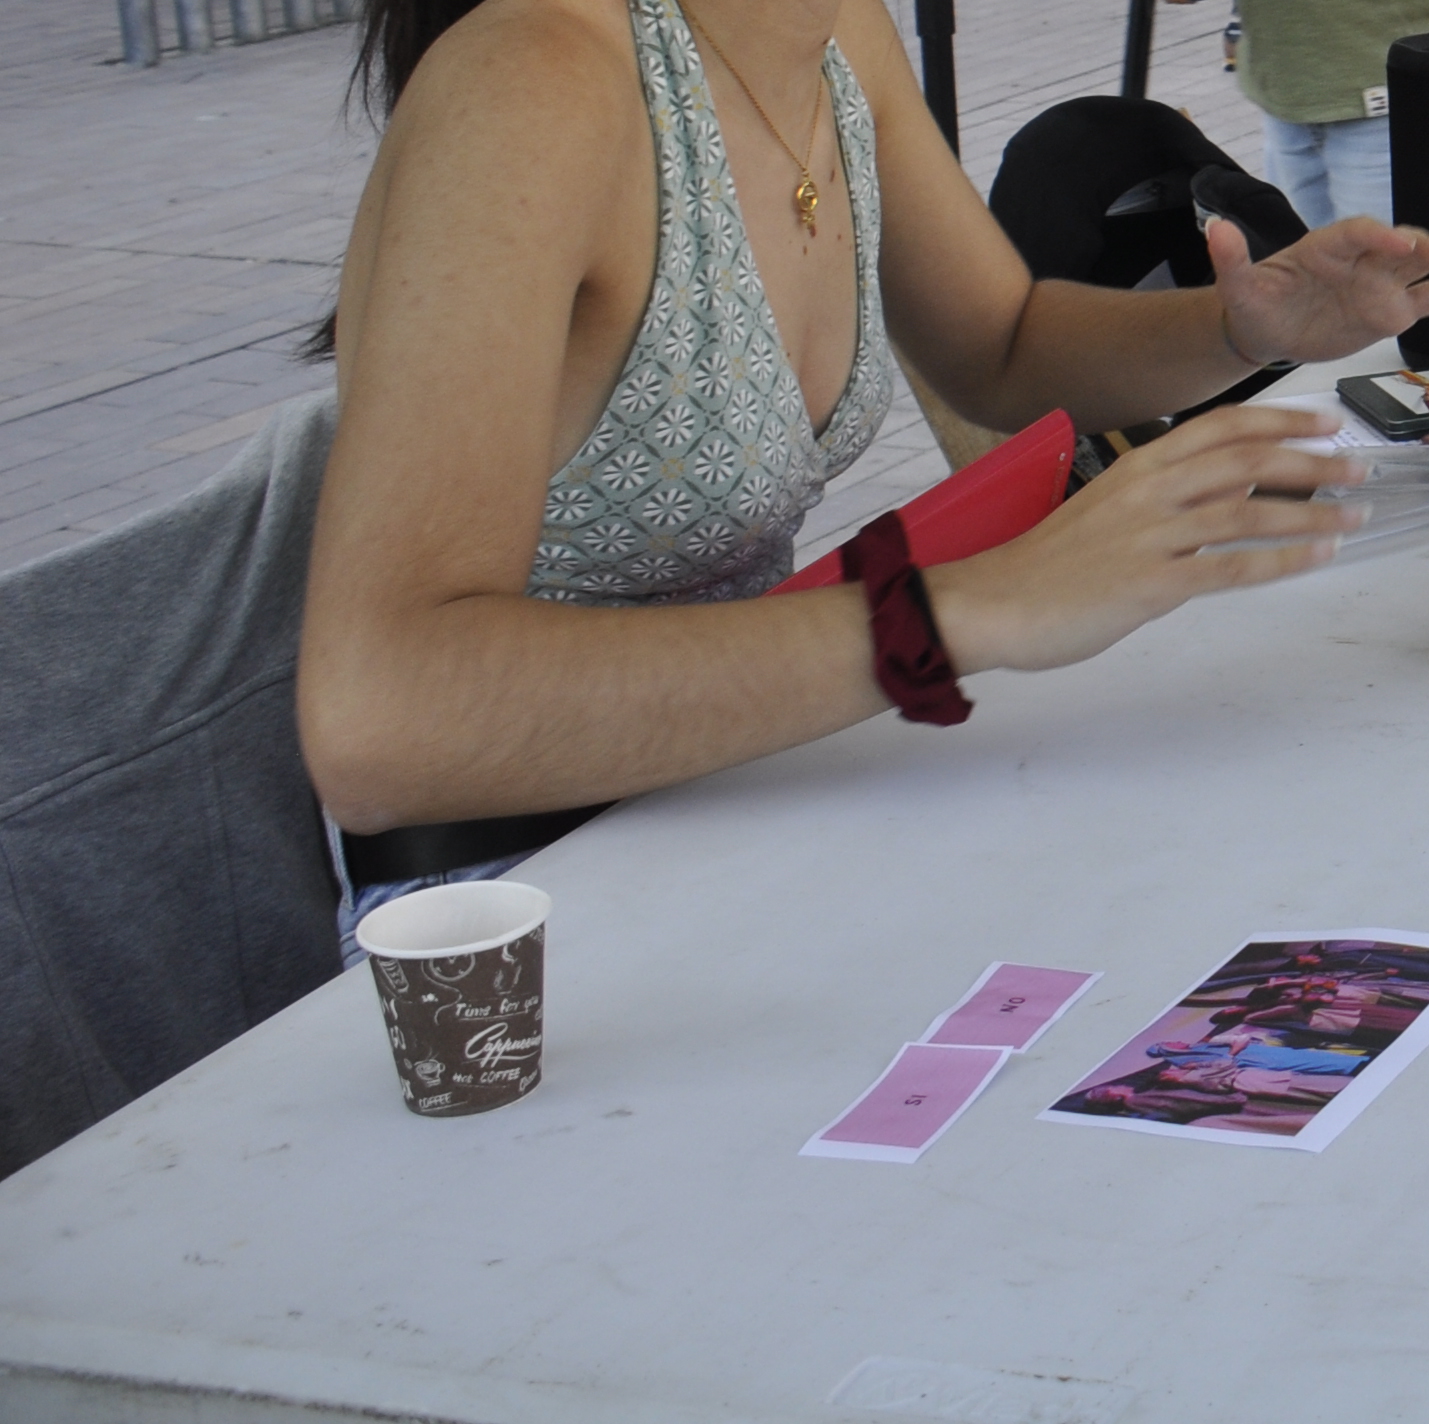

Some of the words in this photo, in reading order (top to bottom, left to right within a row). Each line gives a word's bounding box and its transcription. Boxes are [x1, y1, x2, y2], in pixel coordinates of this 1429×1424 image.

[455, 1002, 492, 1017] Time
[500, 998, 519, 1014] for
[999, 997, 1026, 1013] NO
[480, 1067, 522, 1083] COFFEE
[418, 1092, 452, 1108] COFFEE
[904, 1094, 928, 1106] SI
